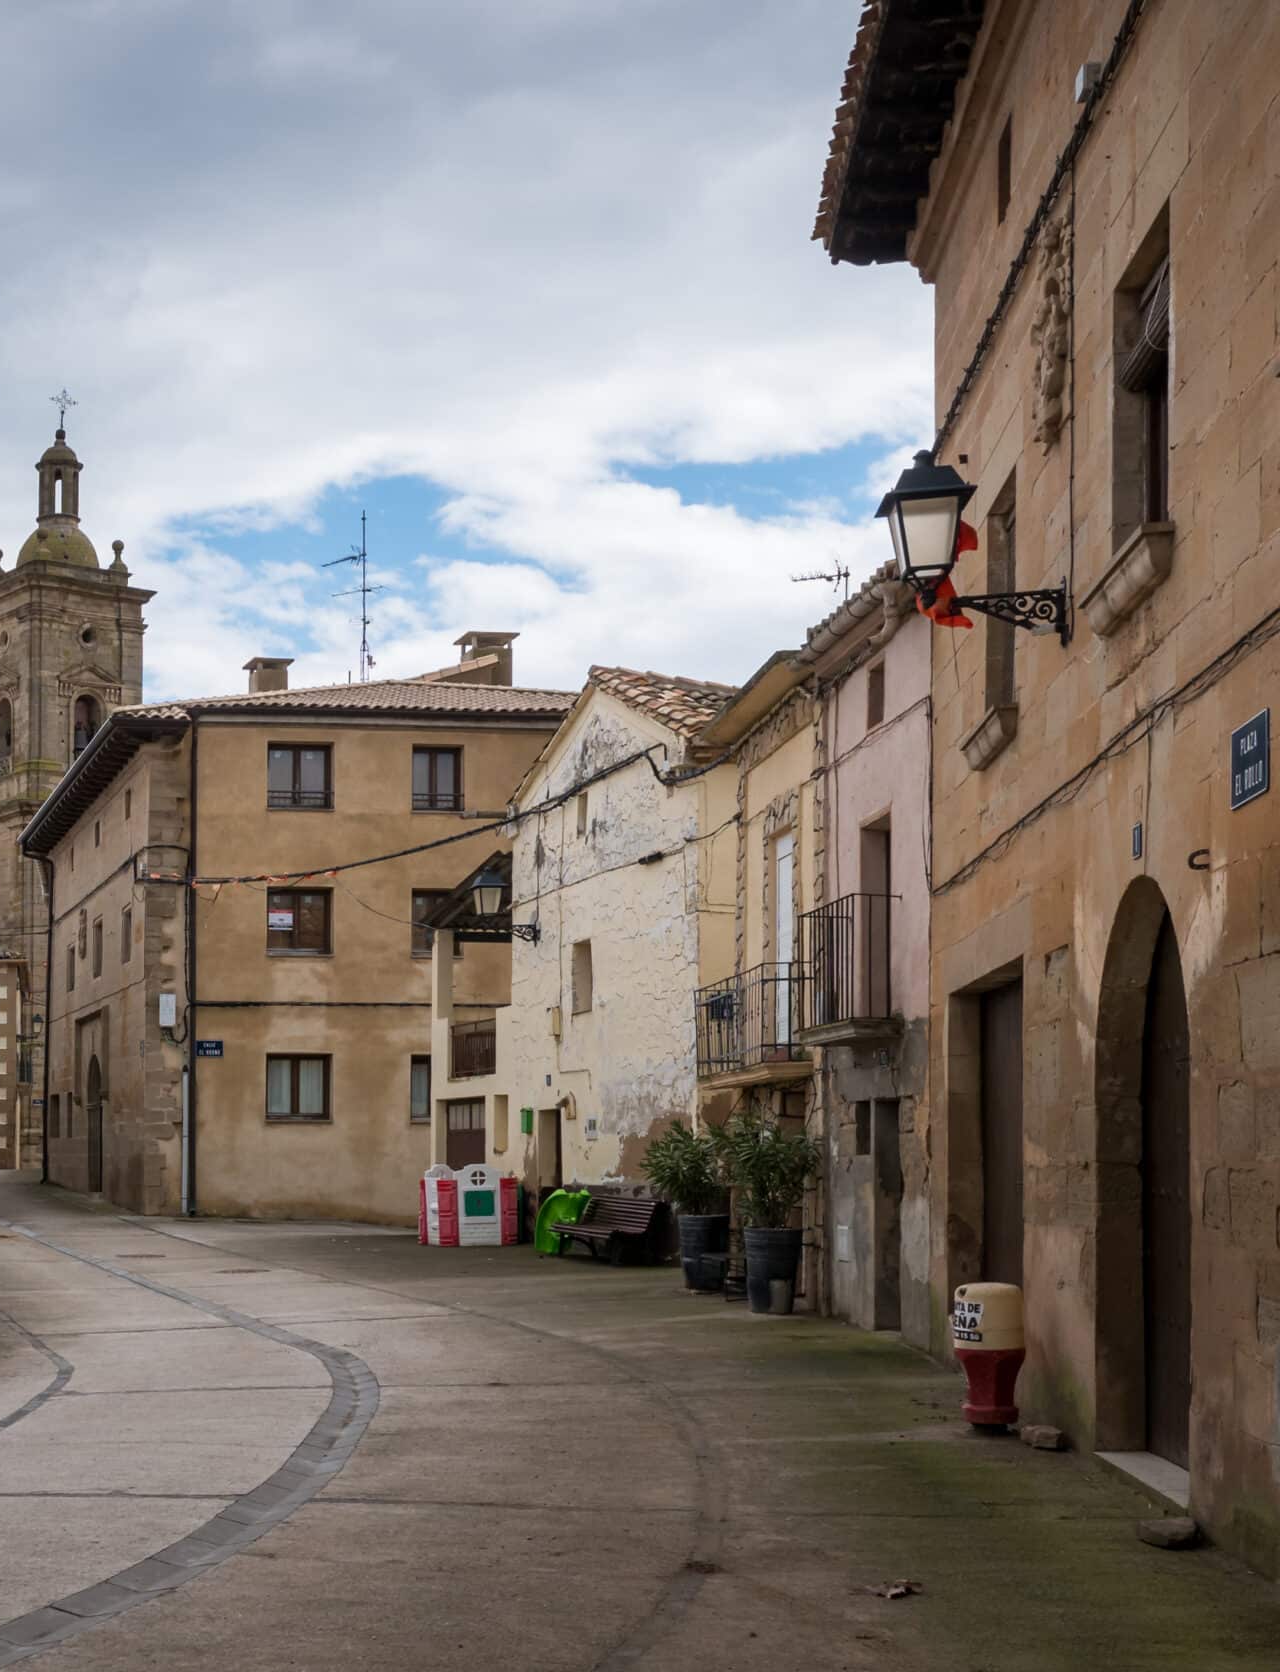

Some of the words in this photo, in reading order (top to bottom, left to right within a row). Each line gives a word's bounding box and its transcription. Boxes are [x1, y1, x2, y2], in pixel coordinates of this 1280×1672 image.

[1240, 730, 1258, 757] PLAZA
[1235, 773, 1242, 797] EL
[1244, 760, 1264, 791] ROLLO
[967, 1303, 981, 1313] DE
